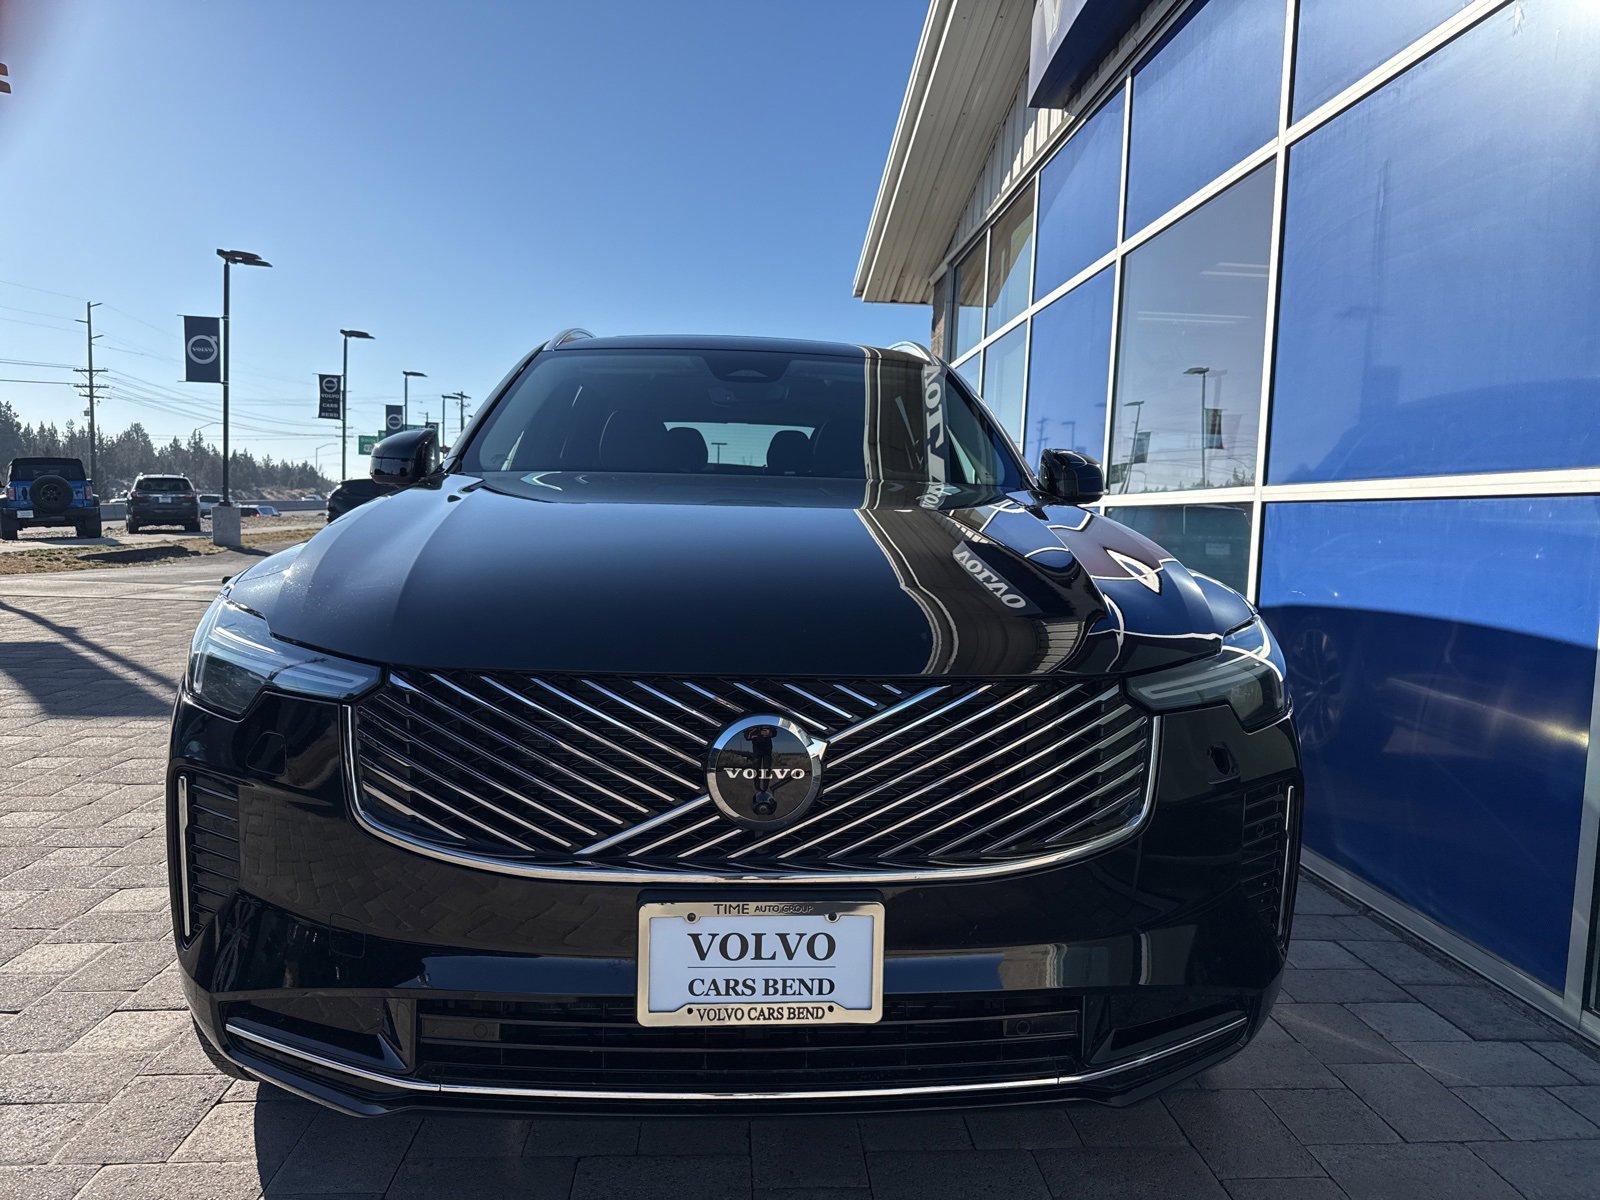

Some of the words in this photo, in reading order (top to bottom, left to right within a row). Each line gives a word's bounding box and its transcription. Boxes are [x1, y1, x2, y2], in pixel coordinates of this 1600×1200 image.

[724, 768, 805, 779] VOLVO
[713, 904, 749, 914] TIME
[754, 905, 780, 913] AUTO
[781, 904, 813, 913] GROUP
[687, 932, 836, 961] VOLVO
[688, 978, 756, 996] CARS
[762, 978, 835, 996] BEND
[697, 1008, 744, 1021] VOLVO
[748, 1007, 783, 1020] CARS
[787, 1007, 825, 1020] BEND
